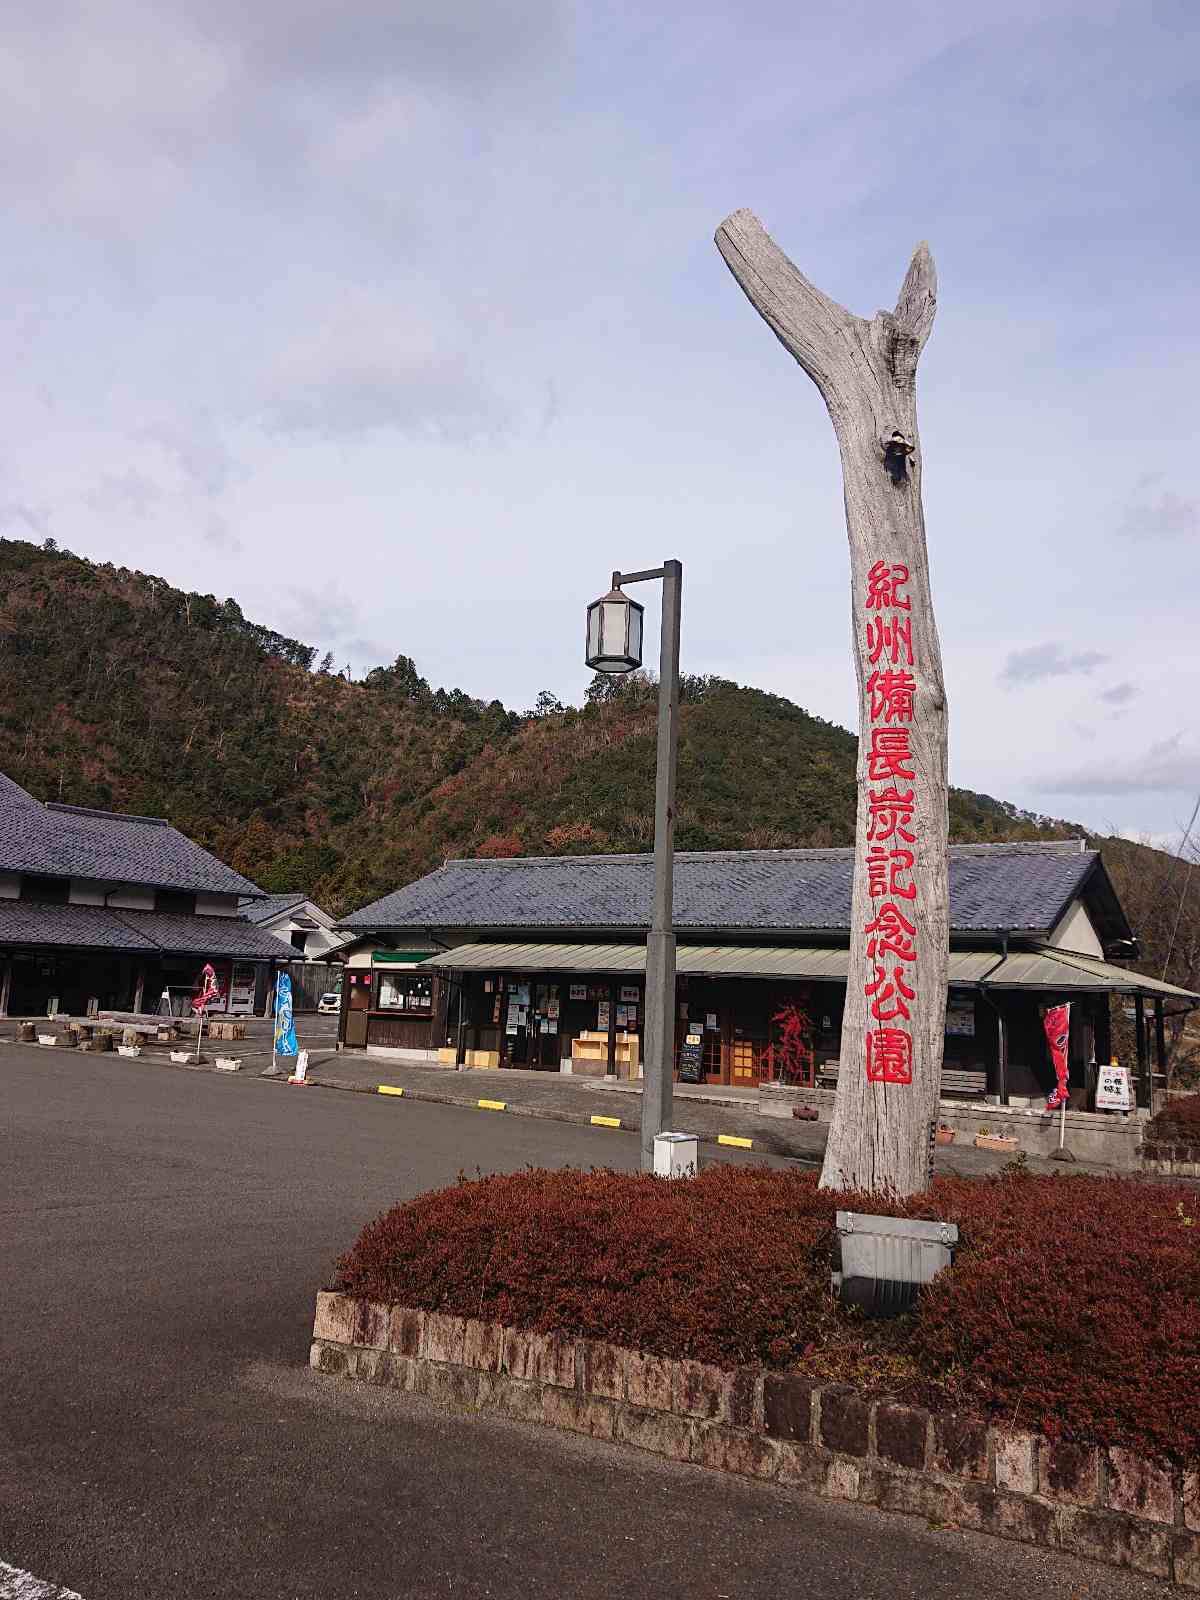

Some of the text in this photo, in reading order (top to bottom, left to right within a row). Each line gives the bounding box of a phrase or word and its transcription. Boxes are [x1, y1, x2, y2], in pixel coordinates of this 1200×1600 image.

[863, 560, 918, 1085] 紀州備長炭記念公園
